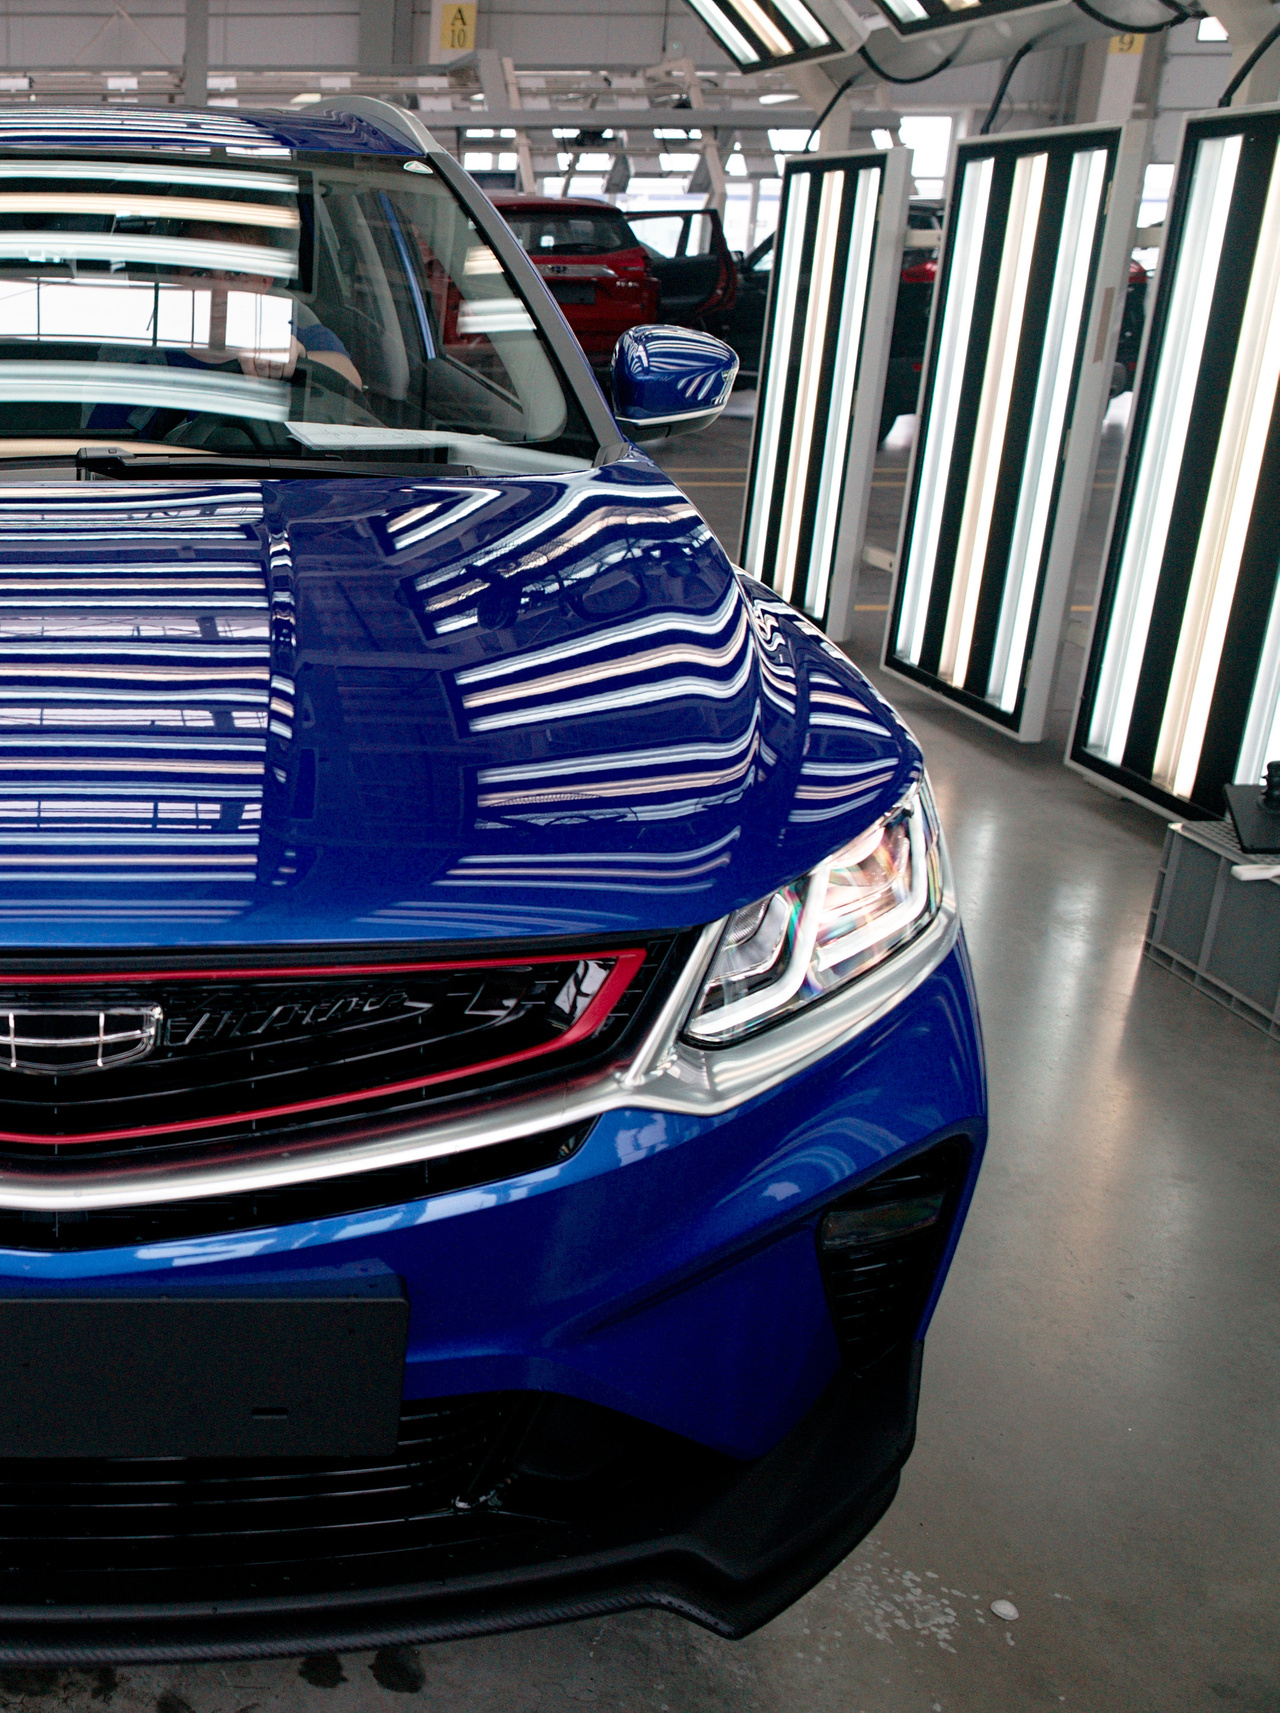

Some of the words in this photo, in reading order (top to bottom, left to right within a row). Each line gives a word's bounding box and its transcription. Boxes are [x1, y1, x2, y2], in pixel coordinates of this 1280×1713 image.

[451, 7, 466, 26] A
[450, 28, 467, 48] 10
[1119, 33, 1135, 52] 9
